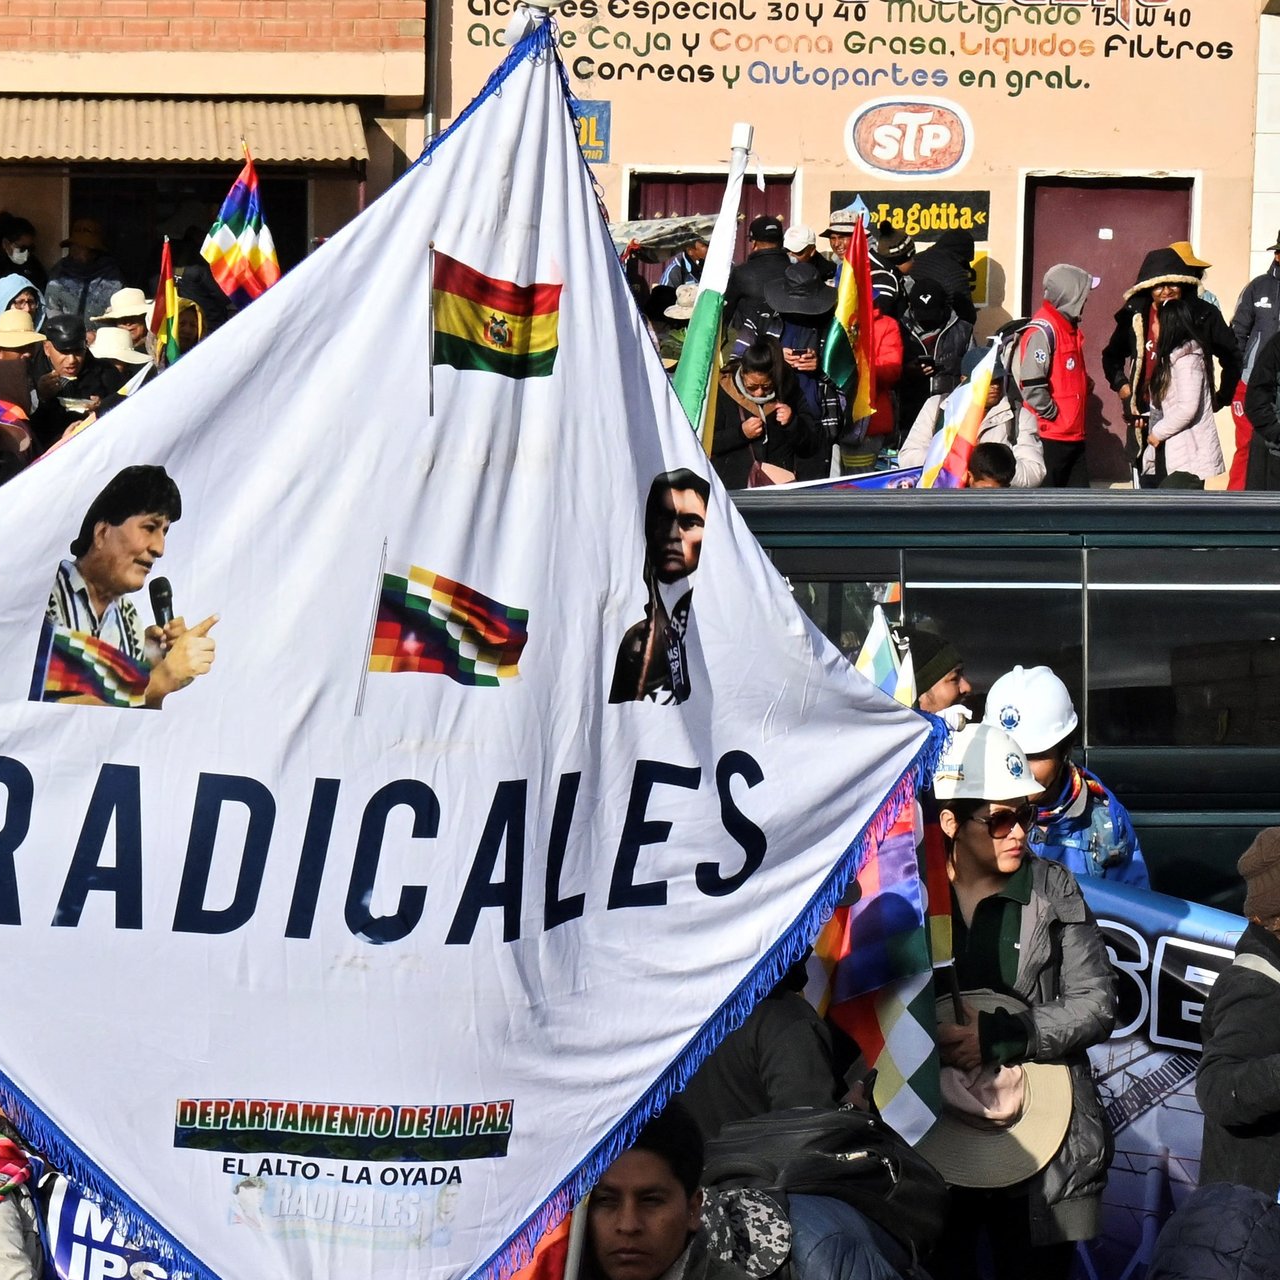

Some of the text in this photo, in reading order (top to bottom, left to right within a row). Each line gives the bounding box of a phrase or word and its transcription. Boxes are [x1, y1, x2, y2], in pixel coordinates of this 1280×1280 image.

[767, 1, 800, 22] 30
[832, 2, 867, 23] 40
[1163, 7, 1192, 28] 40
[588, 25, 672, 57] Caja
[709, 28, 834, 54] Corona
[572, 55, 715, 84] Correas
[958, 63, 996, 89] en
[1006, 64, 1091, 97] gral.
[872, 110, 952, 162] STP
[176, 1099, 513, 1139] DEPARTAMENTO DE LA PAZ
[222, 1157, 250, 1177] EL
[257, 1158, 320, 1180] ALTO
[341, 1165, 372, 1185] LA
[379, 1165, 463, 1186] OYADA
[272, 1181, 422, 1228] RADICALES
